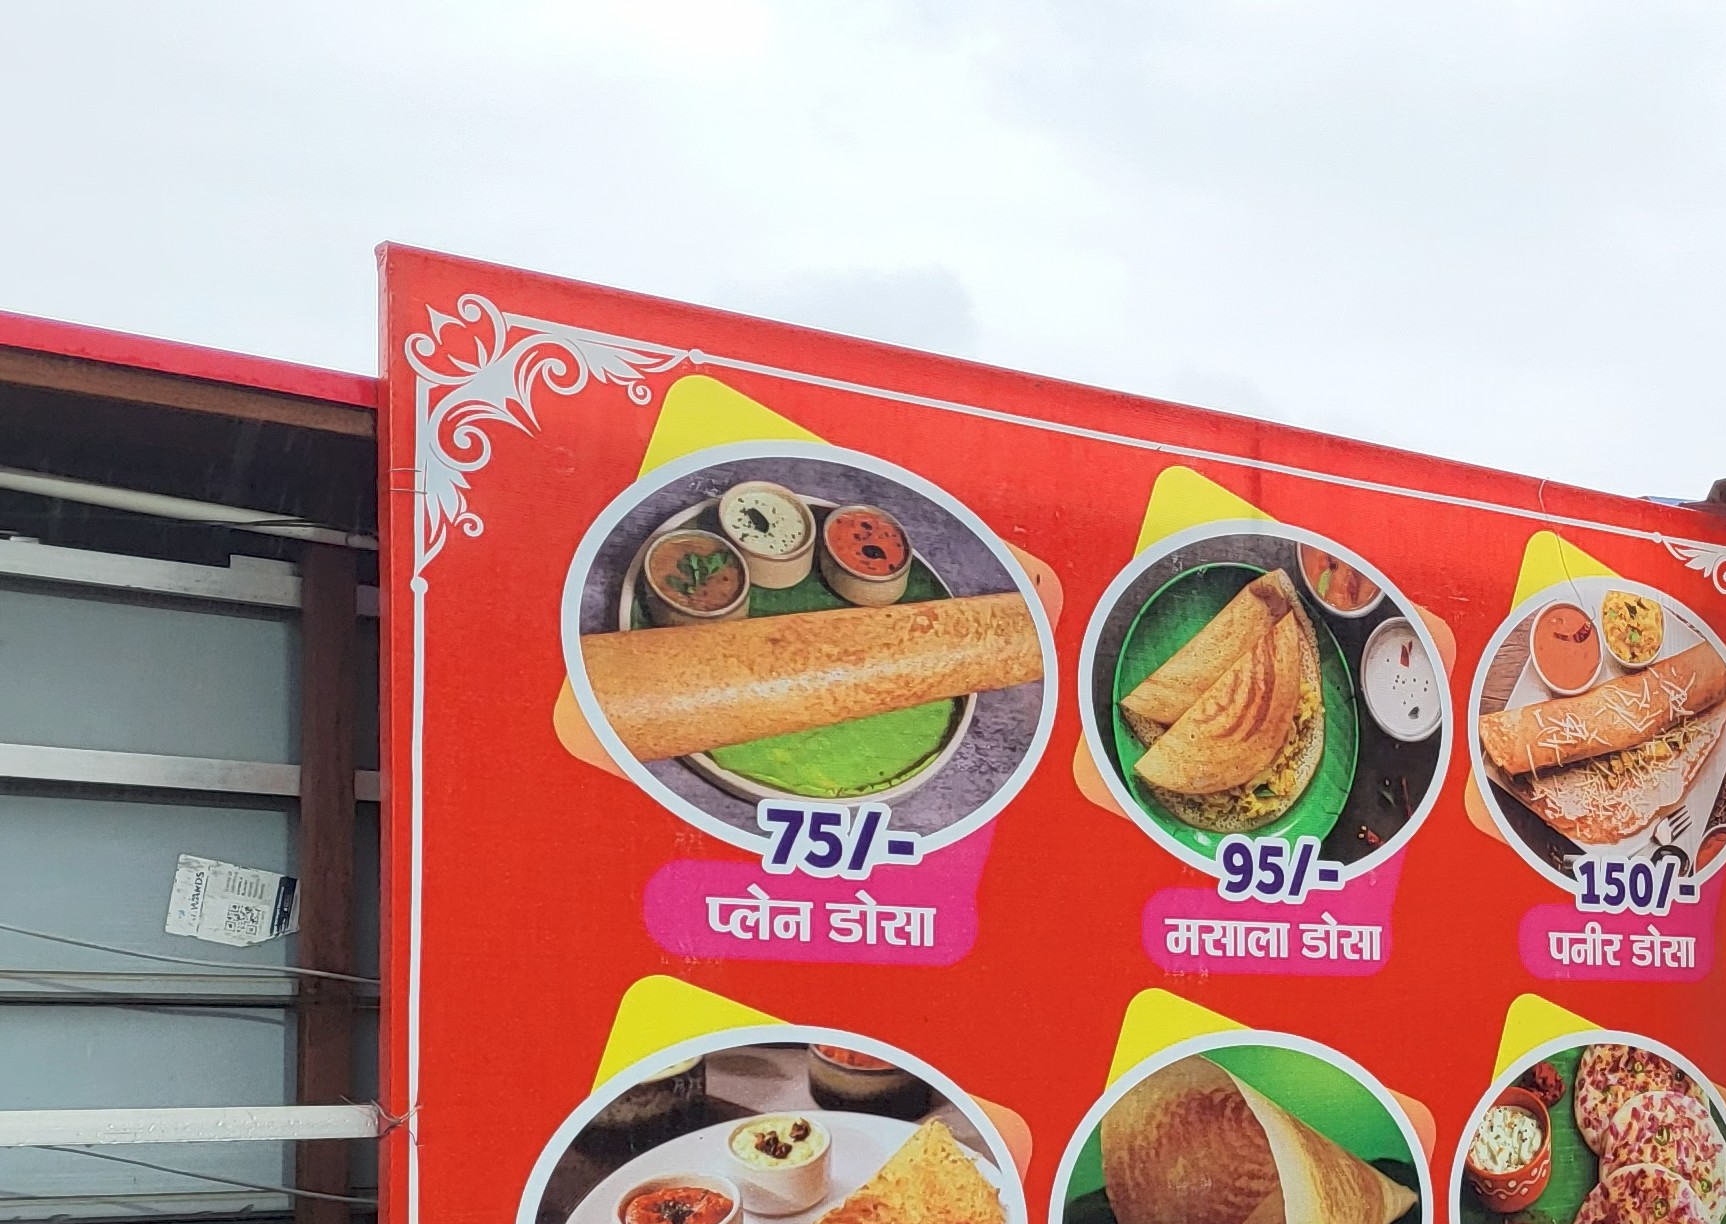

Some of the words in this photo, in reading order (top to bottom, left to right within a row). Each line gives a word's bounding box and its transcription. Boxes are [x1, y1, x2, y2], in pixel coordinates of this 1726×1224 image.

[766, 807, 915, 871] 75/-
[1222, 841, 1339, 897] 95/-
[1578, 860, 1696, 909] 150/-
[706, 883, 813, 941] प्लेन
[826, 889, 936, 947] डोसा
[1164, 918, 1290, 958] मसाला
[1299, 911, 1382, 961] डोसा
[1548, 921, 1623, 966] पनीर
[1629, 924, 1696, 967] डोसा
